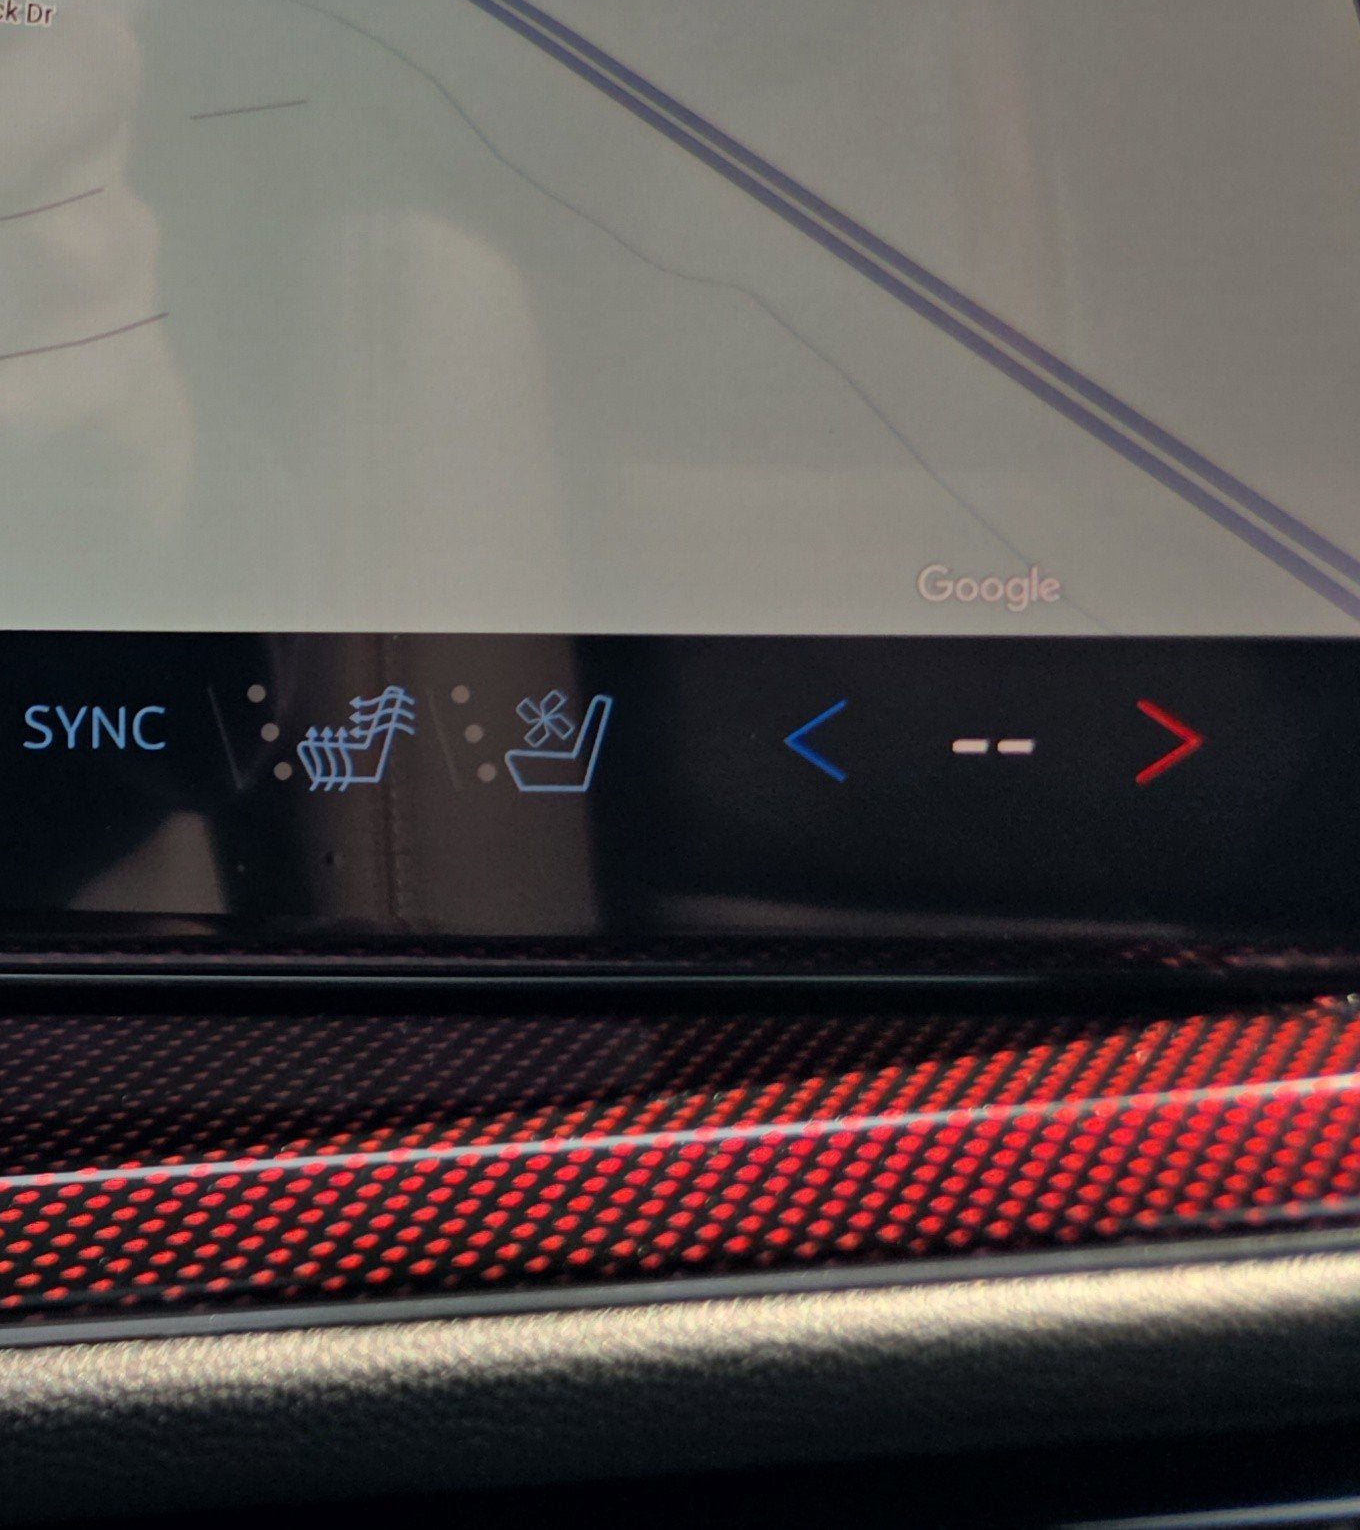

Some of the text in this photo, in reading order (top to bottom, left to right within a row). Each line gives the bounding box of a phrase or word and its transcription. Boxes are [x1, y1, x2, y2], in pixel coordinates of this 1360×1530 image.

[26, 2, 54, 25] Dr
[916, 565, 1061, 612] Google
[22, 704, 168, 751] SYNC
